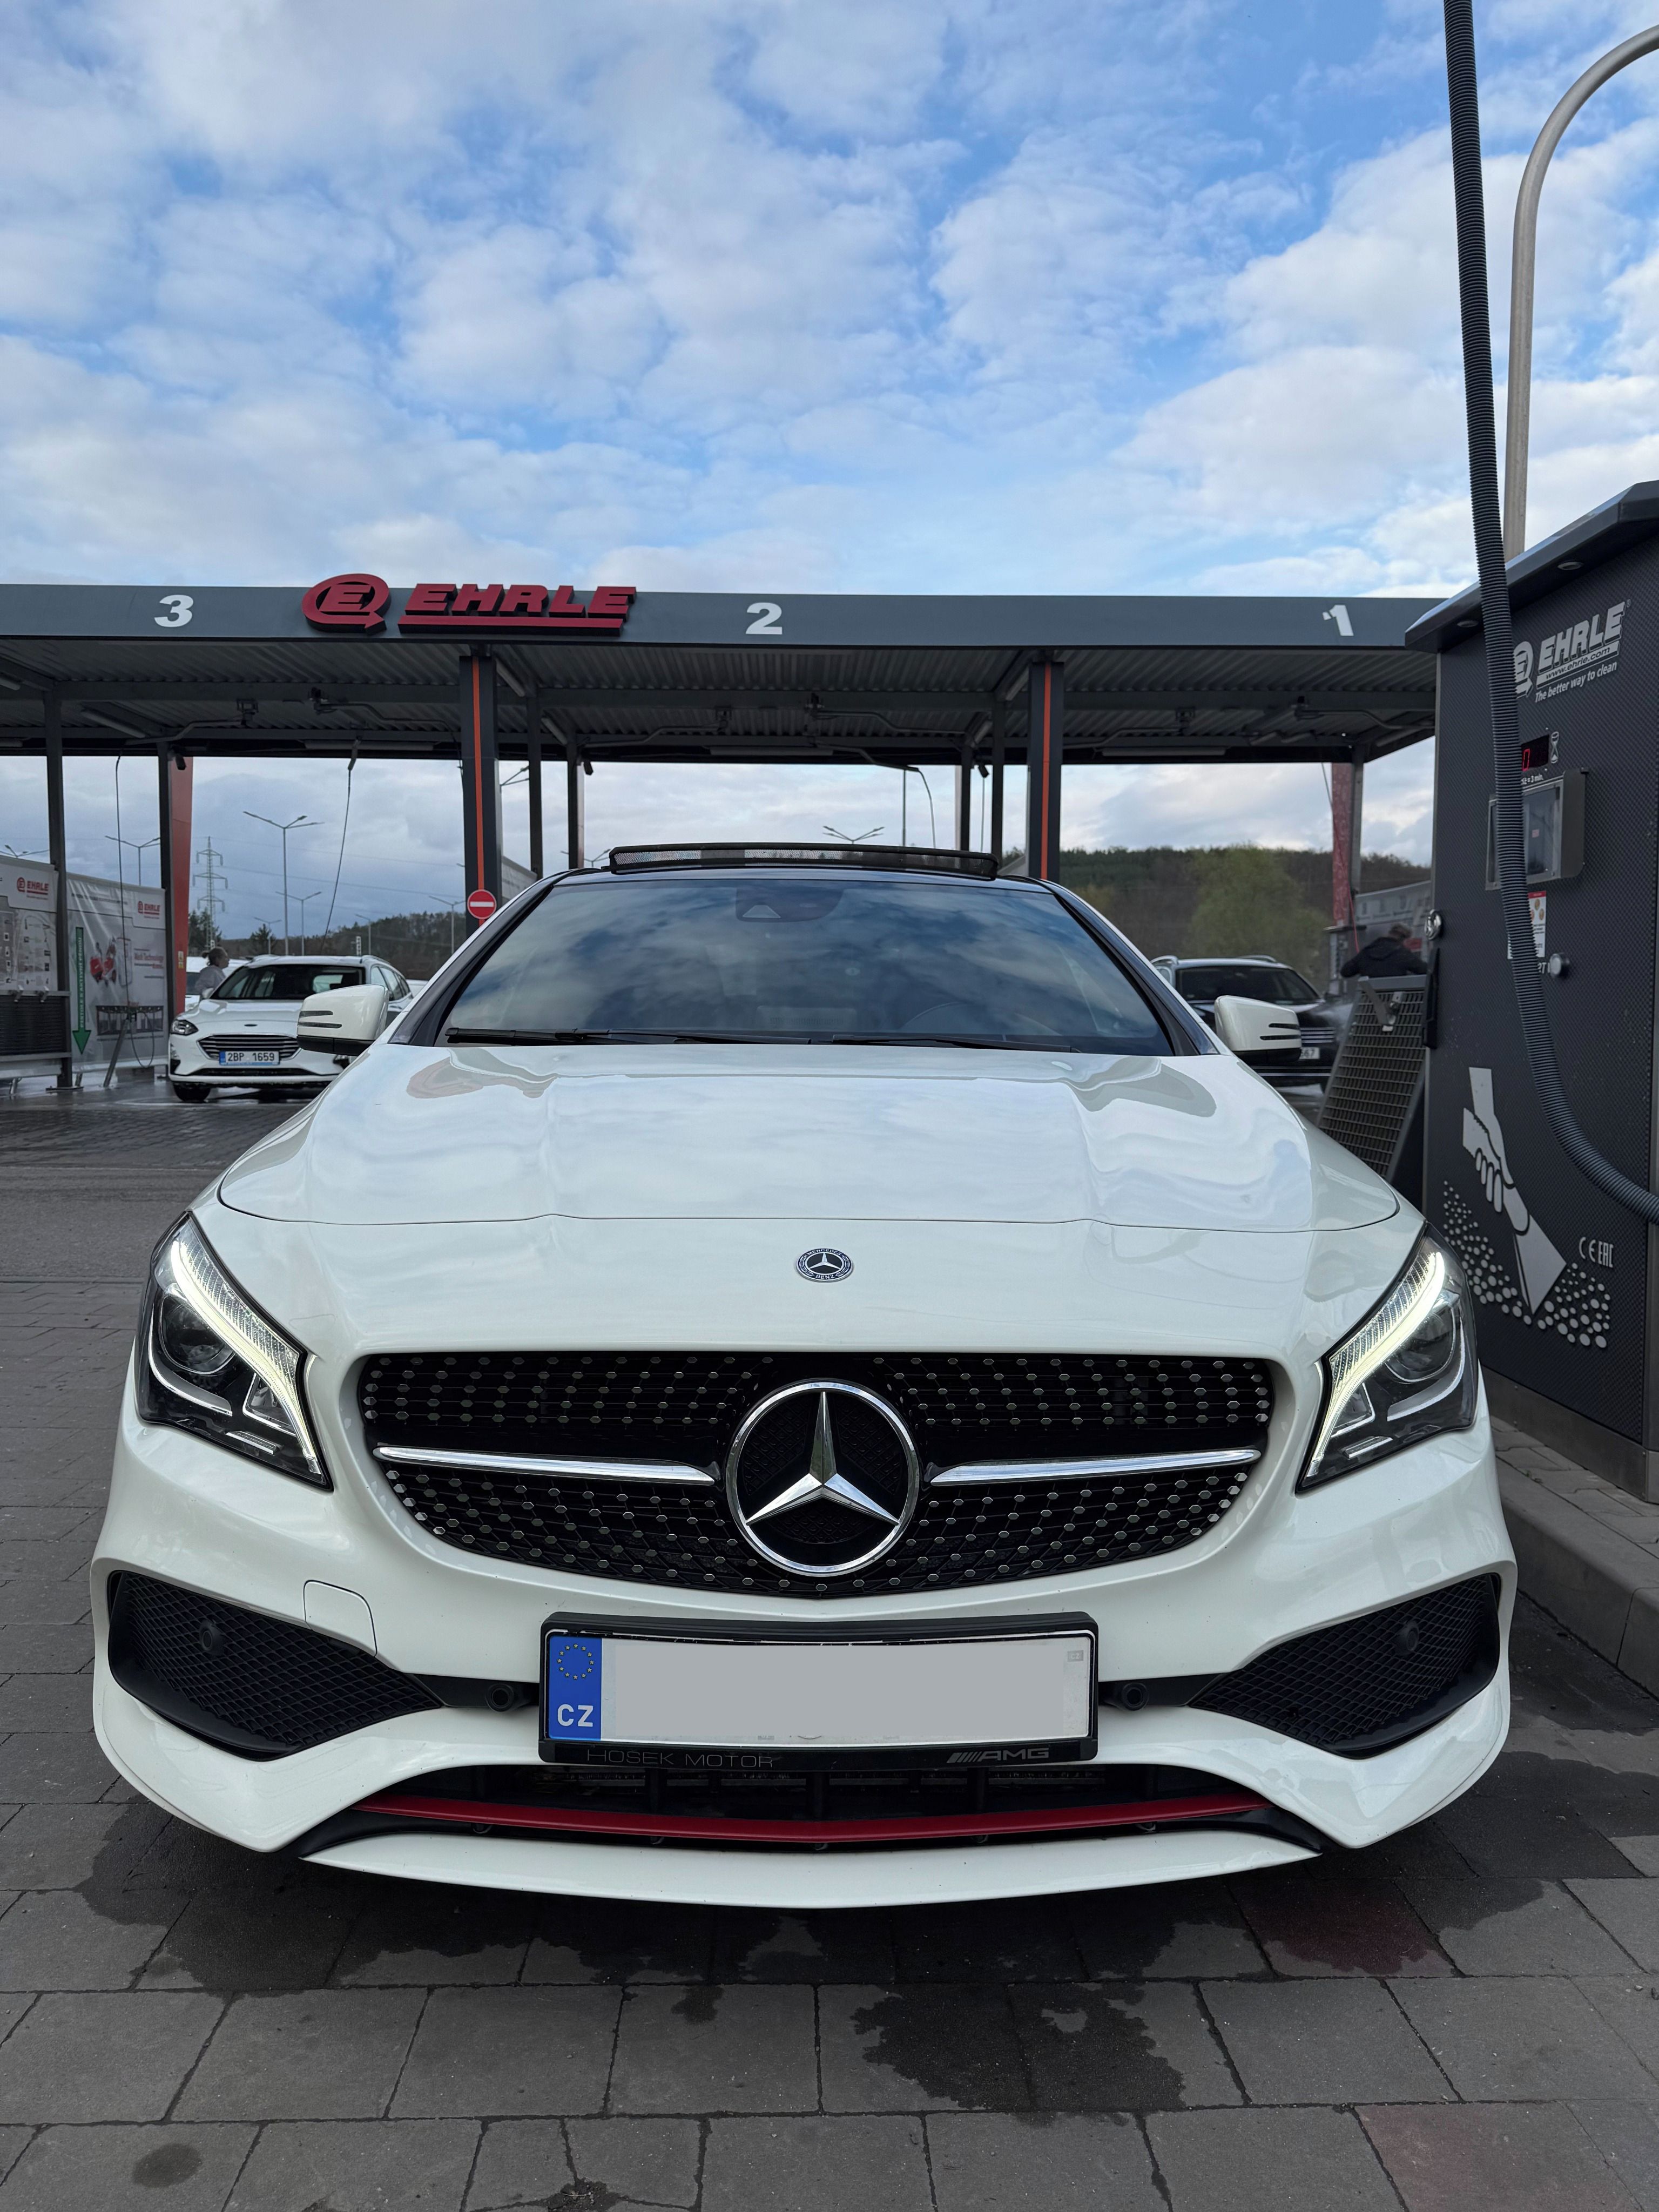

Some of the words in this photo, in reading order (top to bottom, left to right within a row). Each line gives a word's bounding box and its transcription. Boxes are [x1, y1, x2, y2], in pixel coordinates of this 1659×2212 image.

[154, 595, 193, 627] 3
[404, 583, 636, 616] EHRLE
[746, 602, 783, 635] 2
[1322, 604, 1354, 636] 1
[1539, 602, 1625, 671] EHRLE
[1546, 646, 1610, 679] www.ehrle.com
[1535, 690, 1547, 703] The
[1548, 681, 1569, 698] better
[1570, 674, 1586, 687] way
[1587, 670, 1595, 681] to
[1597, 662, 1617, 677] clean
[27, 881, 49, 891] EHRLE
[227, 1053, 244, 1062] 2BP
[252, 1053, 274, 1062] 1659
[557, 1704, 594, 1727] CZ
[685, 1754, 773, 1768] MOTOR
